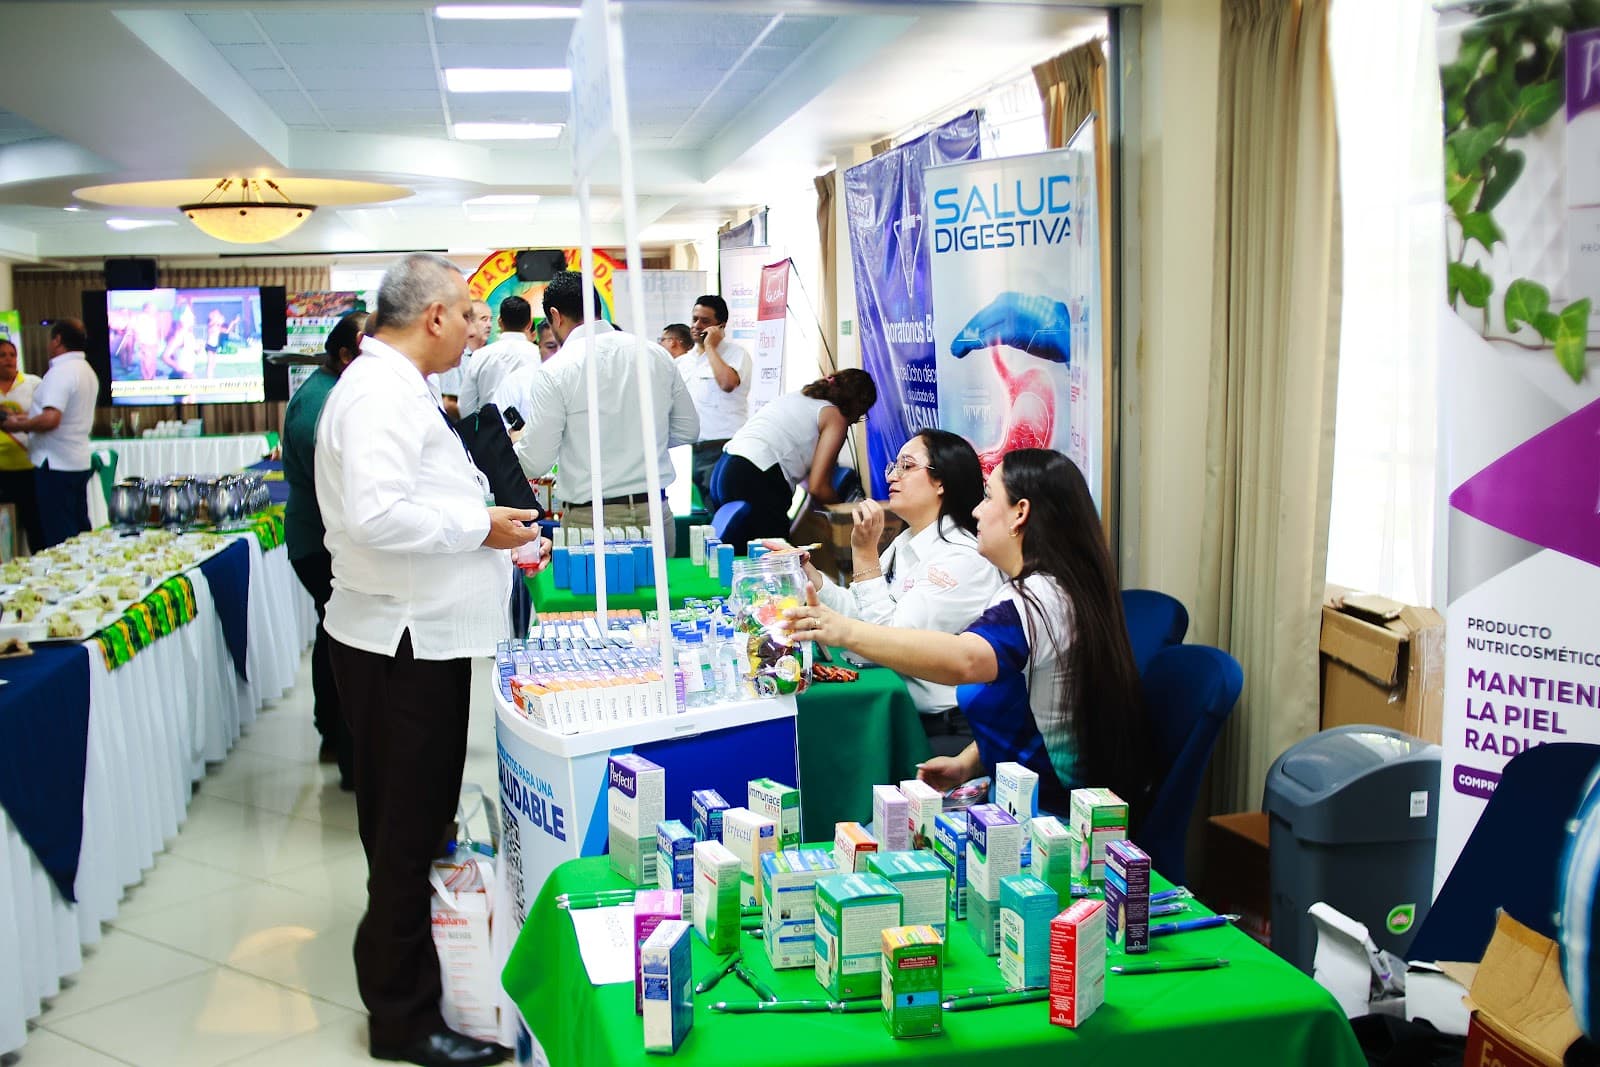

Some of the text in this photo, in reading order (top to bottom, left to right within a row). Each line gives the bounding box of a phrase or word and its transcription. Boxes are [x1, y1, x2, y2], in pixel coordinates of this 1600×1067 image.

[934, 175, 1071, 225] SALUD
[935, 216, 1071, 254] DIGESTIVA
[1468, 616, 1553, 640] PRODUCTO
[1467, 666, 1600, 709] MANTIEN
[1466, 698, 1568, 735] LA PIEL
[1465, 727, 1549, 757] RADI
[518, 764, 535, 787] PARA
[535, 776, 554, 799] UNA
[609, 762, 634, 791] Perfectil
